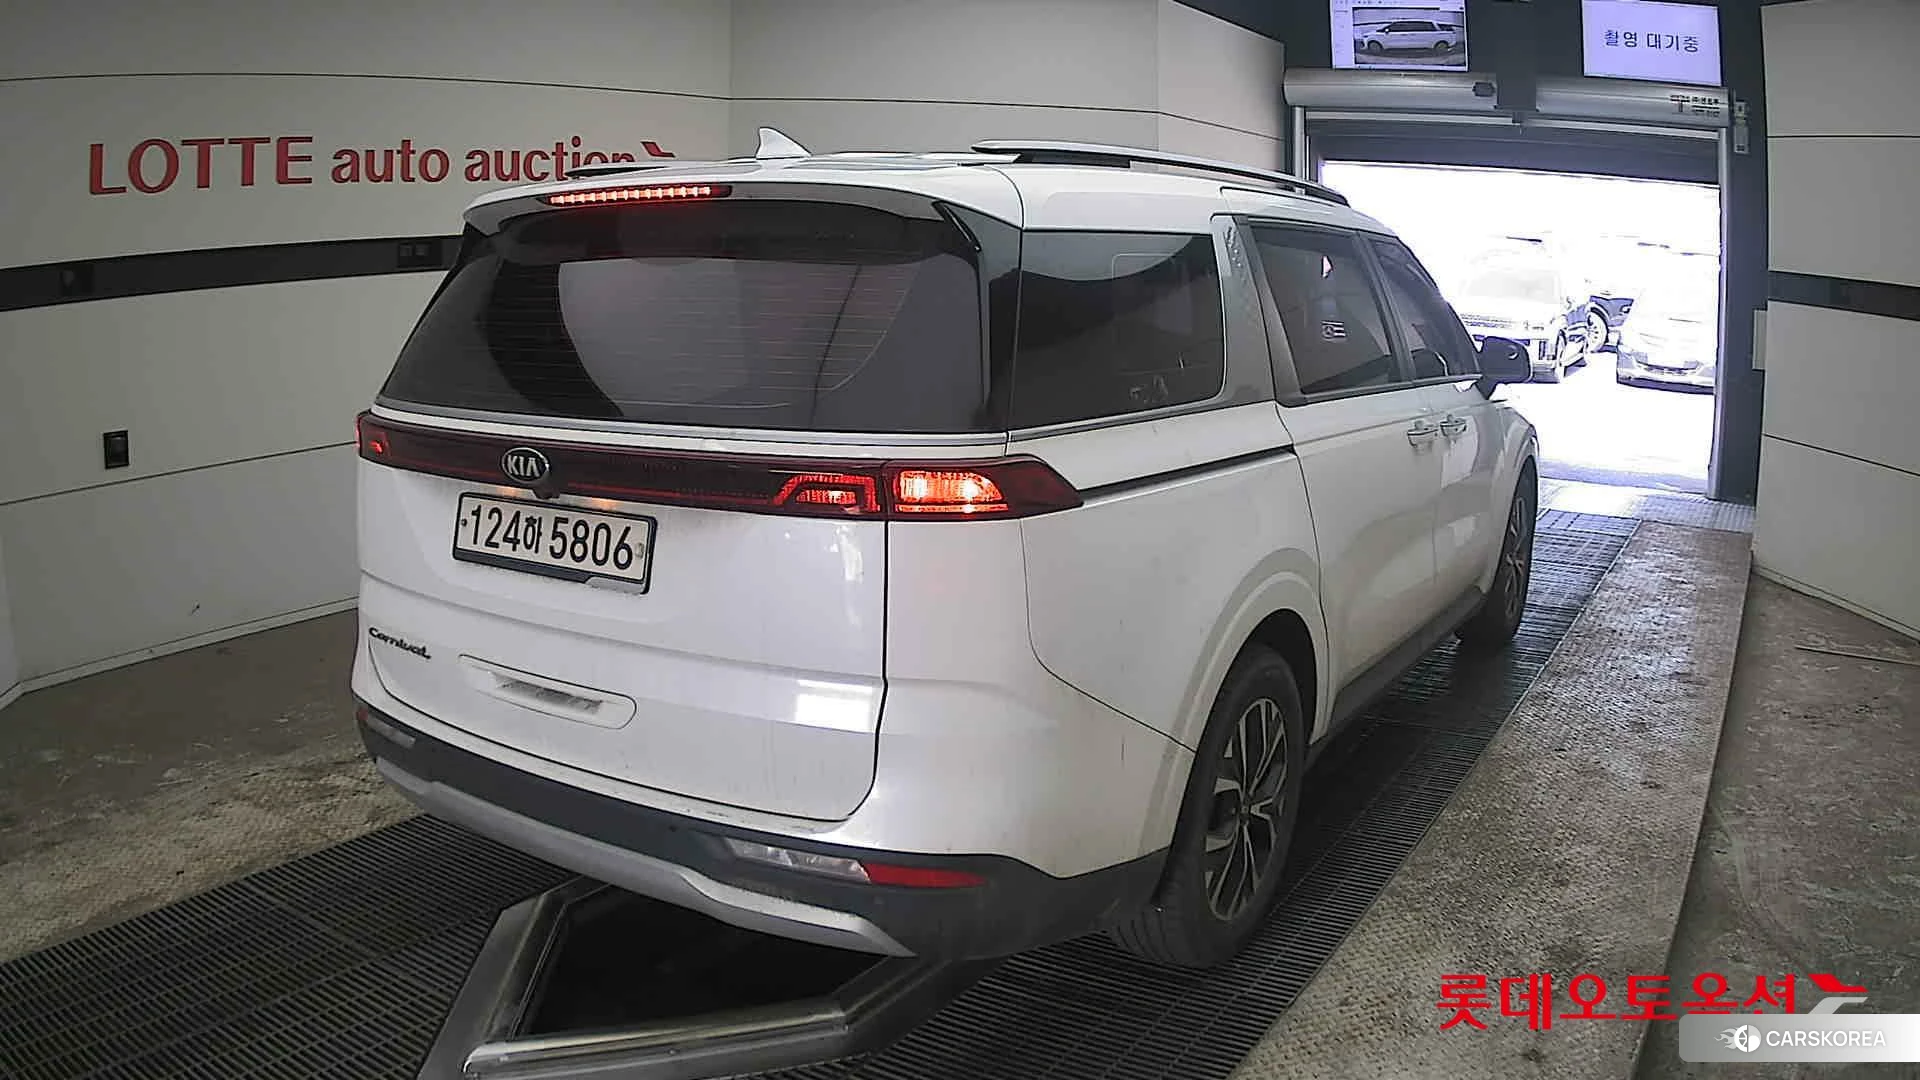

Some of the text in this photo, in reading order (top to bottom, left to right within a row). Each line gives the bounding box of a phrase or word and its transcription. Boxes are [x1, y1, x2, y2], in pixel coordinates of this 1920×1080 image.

[1646, 32, 1699, 53] 대기중
[89, 136, 313, 195] LOTTE
[331, 139, 450, 184] auto
[506, 455, 541, 478] KIA
[471, 504, 634, 570] 124하 5806
